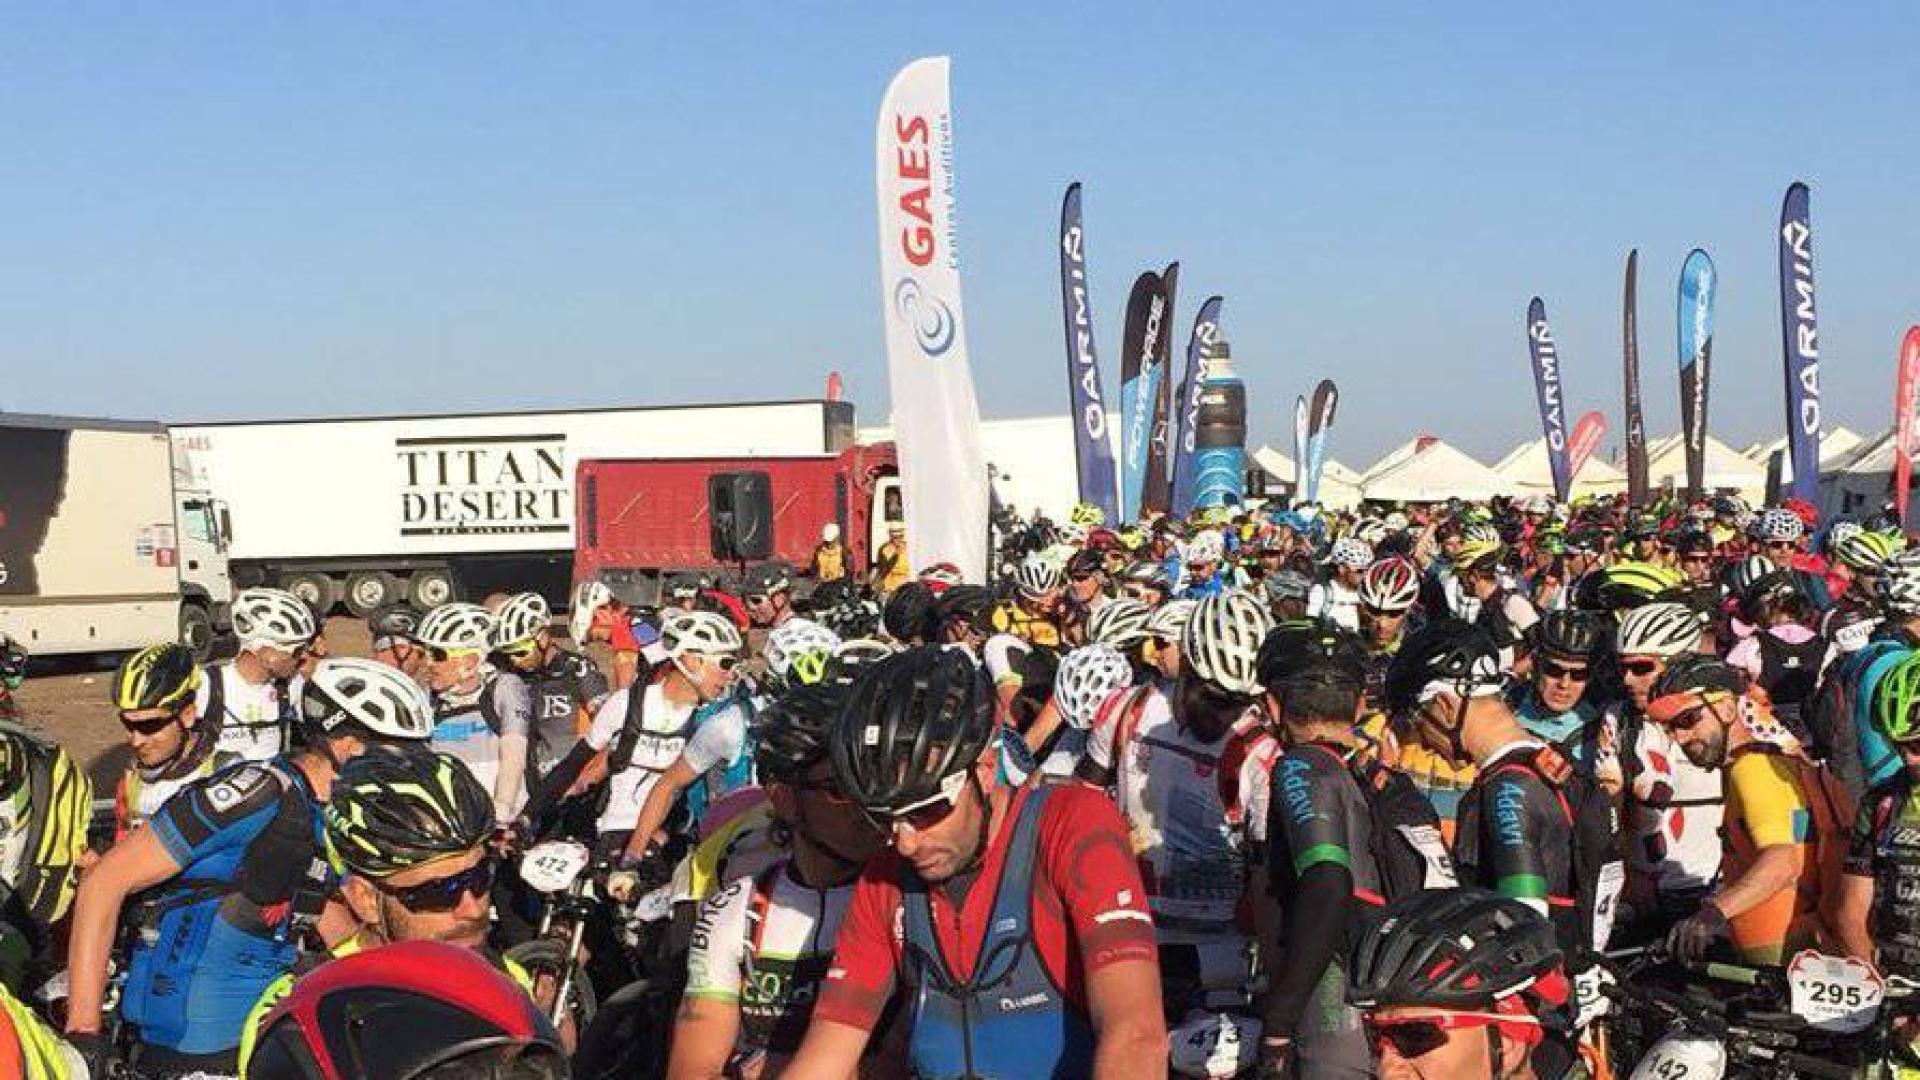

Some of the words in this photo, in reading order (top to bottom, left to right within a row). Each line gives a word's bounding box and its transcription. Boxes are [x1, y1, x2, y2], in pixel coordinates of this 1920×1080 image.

[897, 113, 935, 267] GAES
[1063, 226, 1104, 440] GARMIN
[1783, 221, 1820, 435] GARMIN
[1184, 320, 1219, 454] GARMIN
[1531, 320, 1565, 451] GARMIN
[397, 447, 566, 486] TITAN
[402, 489, 568, 522] DESERT
[535, 856, 569, 874] 472
[1810, 980, 1862, 1007] 295
[1648, 1053, 1689, 1080] 142
